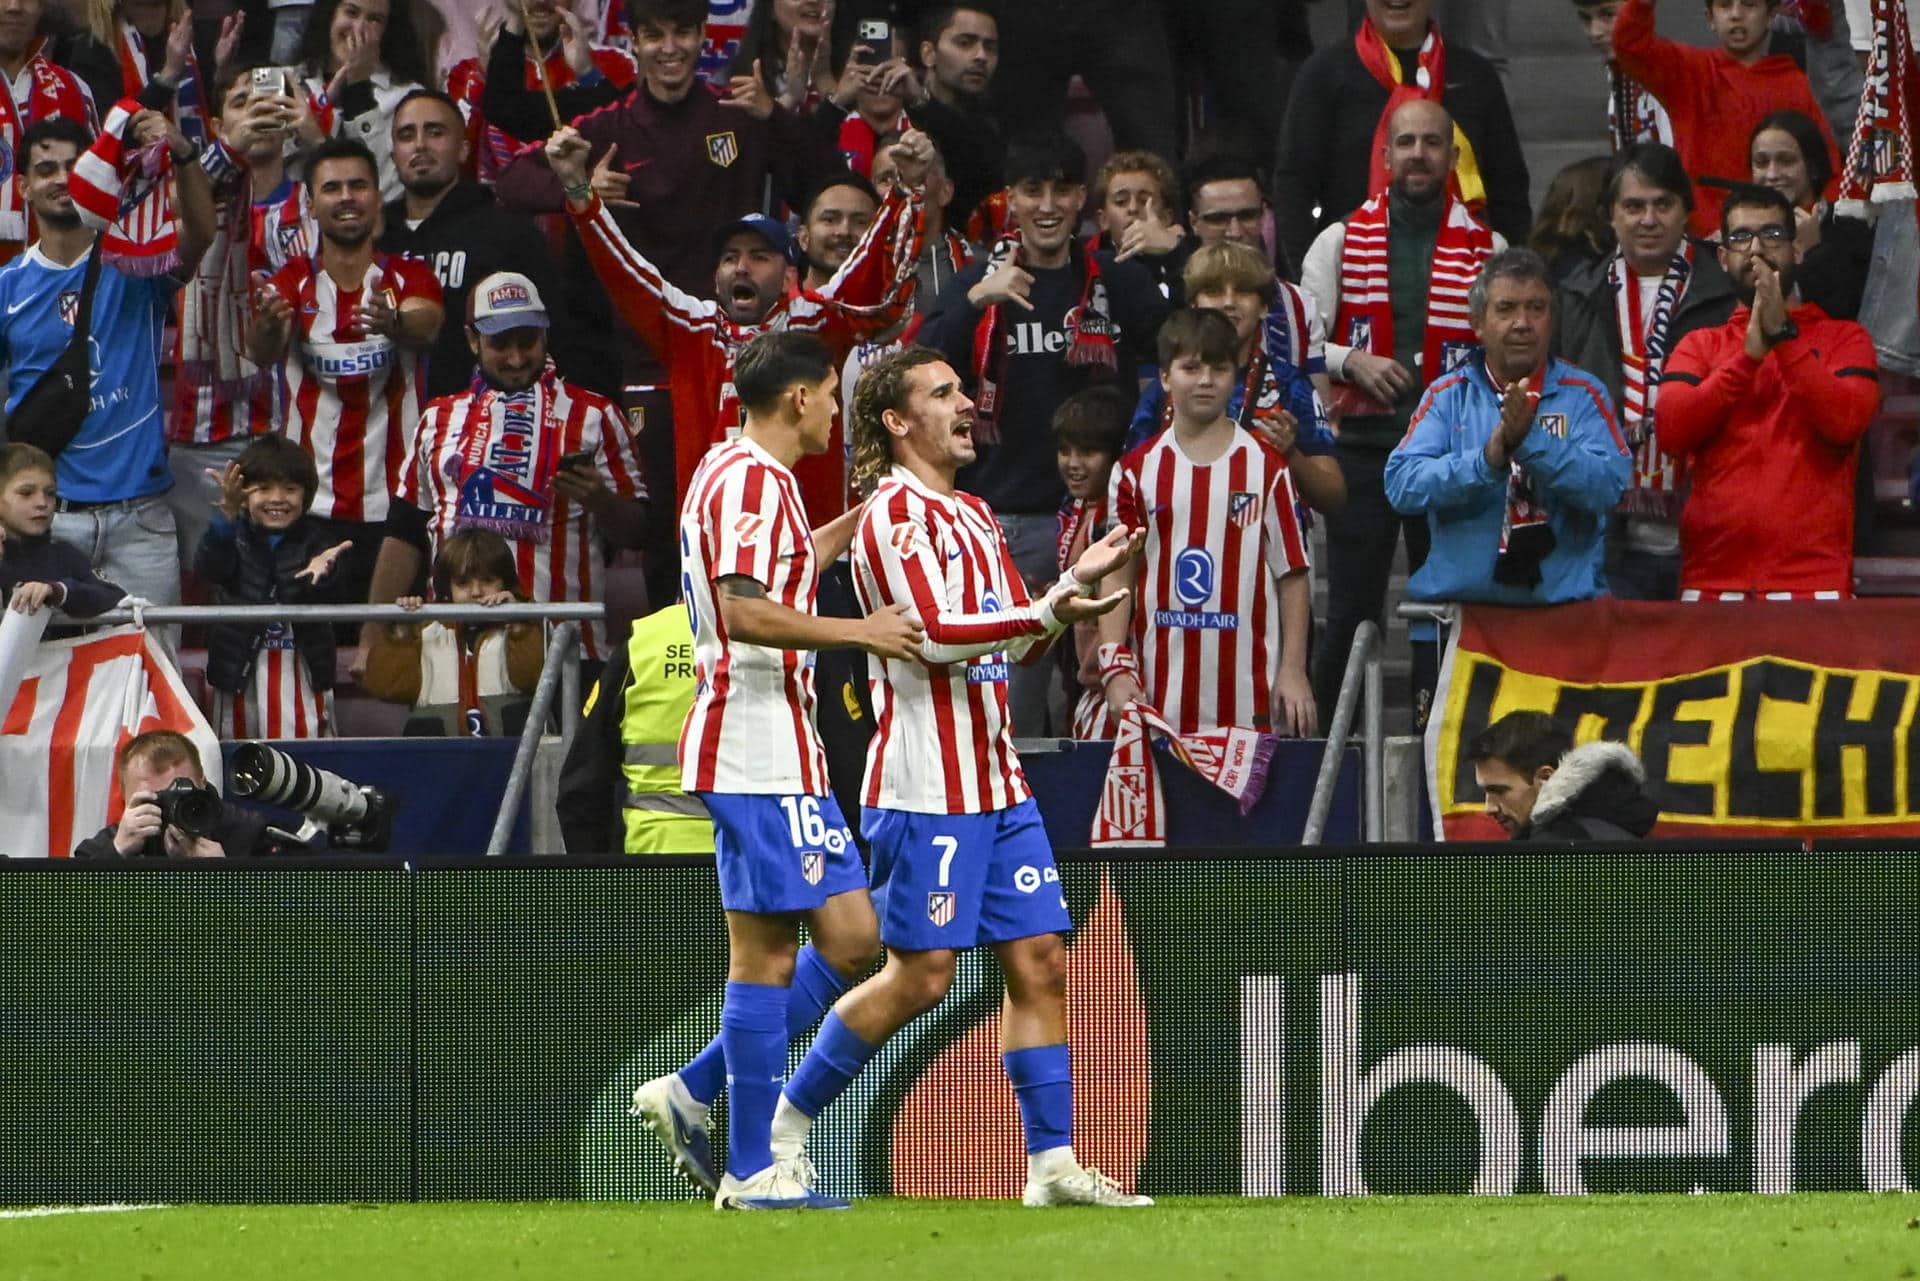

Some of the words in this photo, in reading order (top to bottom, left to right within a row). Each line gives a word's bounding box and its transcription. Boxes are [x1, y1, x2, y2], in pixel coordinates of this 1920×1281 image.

[467, 421, 490, 467] NUNCA
[1059, 514, 1079, 572] ADRID
[1156, 611, 1206, 627] RIYADH
[1210, 614, 1236, 628] AIR
[665, 644, 695, 659] SE
[967, 665, 1008, 681] RIYADH
[780, 795, 826, 849] 16
[931, 835, 959, 888] 7
